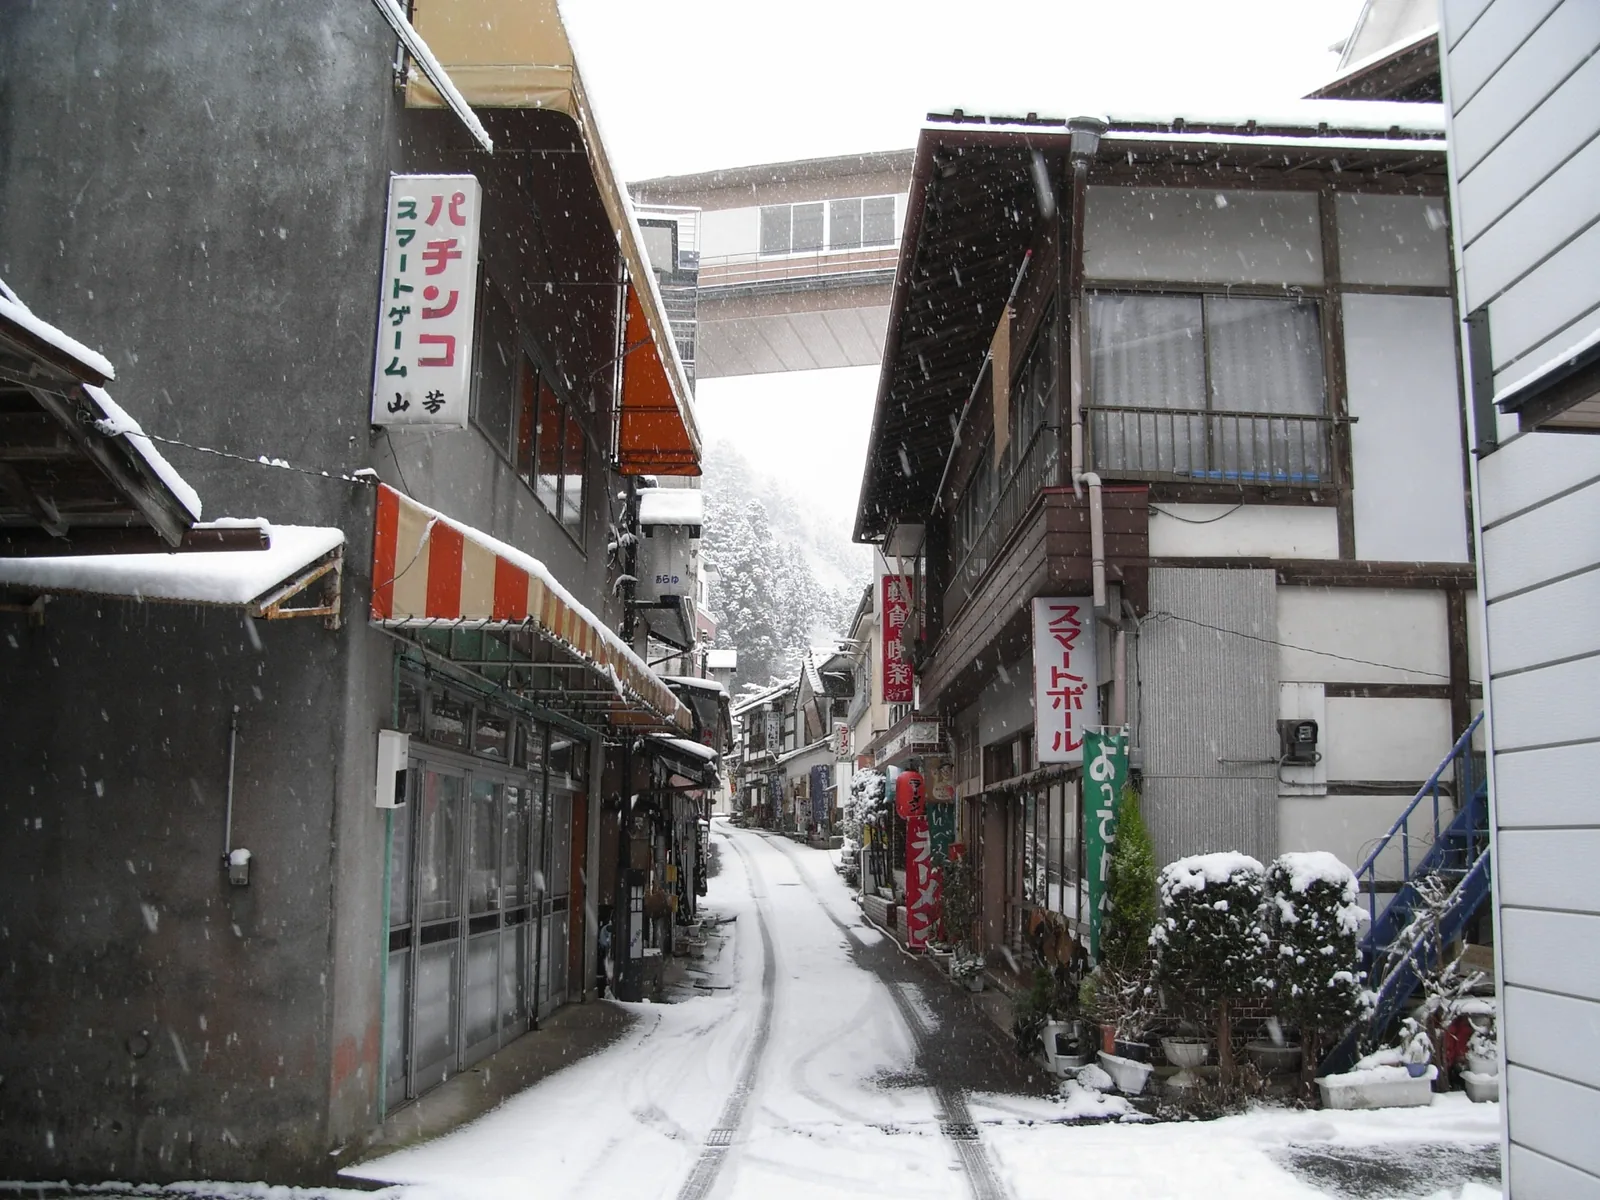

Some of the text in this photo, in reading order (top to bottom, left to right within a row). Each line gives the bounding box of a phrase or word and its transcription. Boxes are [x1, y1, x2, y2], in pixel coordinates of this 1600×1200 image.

[384, 199, 418, 378] スマートゲーム
[418, 191, 466, 367] パチンコ
[840, 726, 849, 756] ラーメン
[1046, 605, 1088, 752] スマートボール
[908, 779, 921, 813] ラーメン
[911, 829, 940, 942] ラーメン
